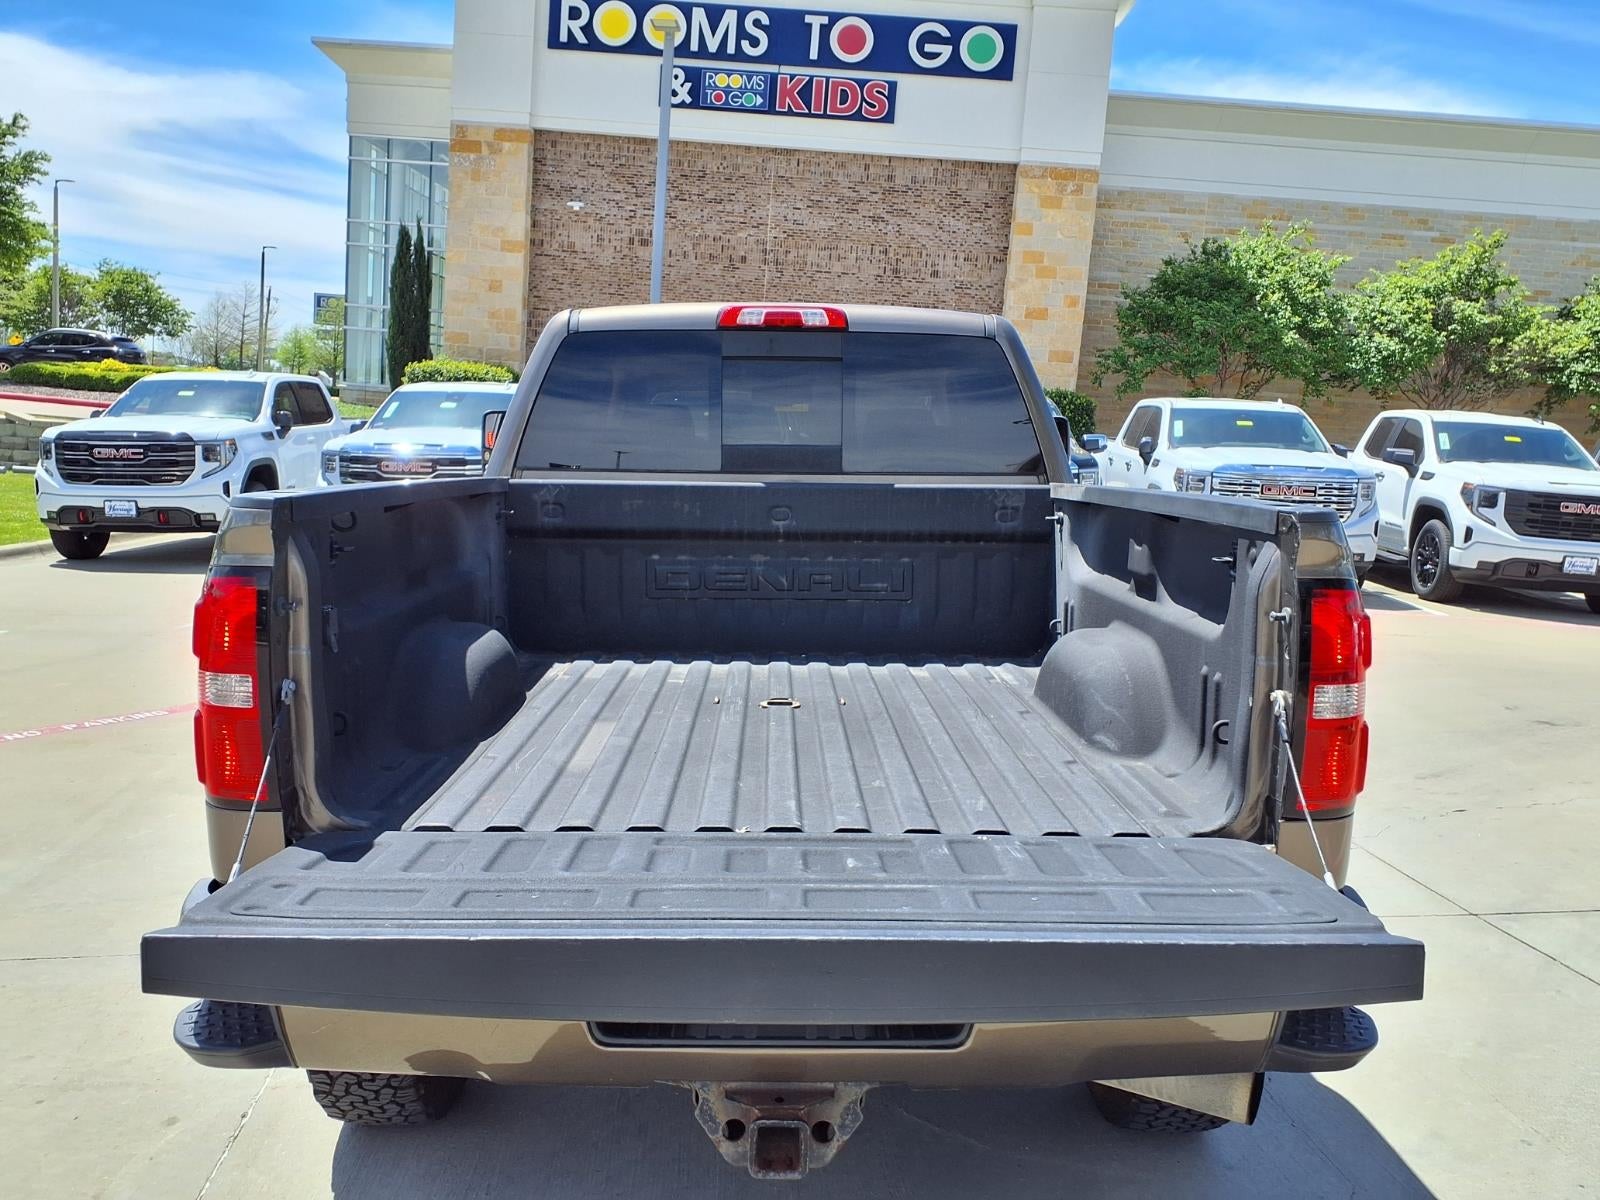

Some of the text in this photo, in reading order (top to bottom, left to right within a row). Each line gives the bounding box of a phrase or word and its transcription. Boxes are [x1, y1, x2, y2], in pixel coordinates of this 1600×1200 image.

[559, 0, 1004, 72] ROOMS TO GO
[670, 67, 692, 105] &
[705, 72, 765, 90] ROOMS
[706, 89, 757, 107] TO GO
[775, 74, 889, 119] KIDS
[93, 448, 144, 458] GMC
[381, 461, 433, 472] GMC
[1263, 485, 1316, 496] GMC
[1560, 502, 1600, 515] GM
[654, 565, 906, 592] DENALI
[4, 709, 169, 741] NO PARKING
